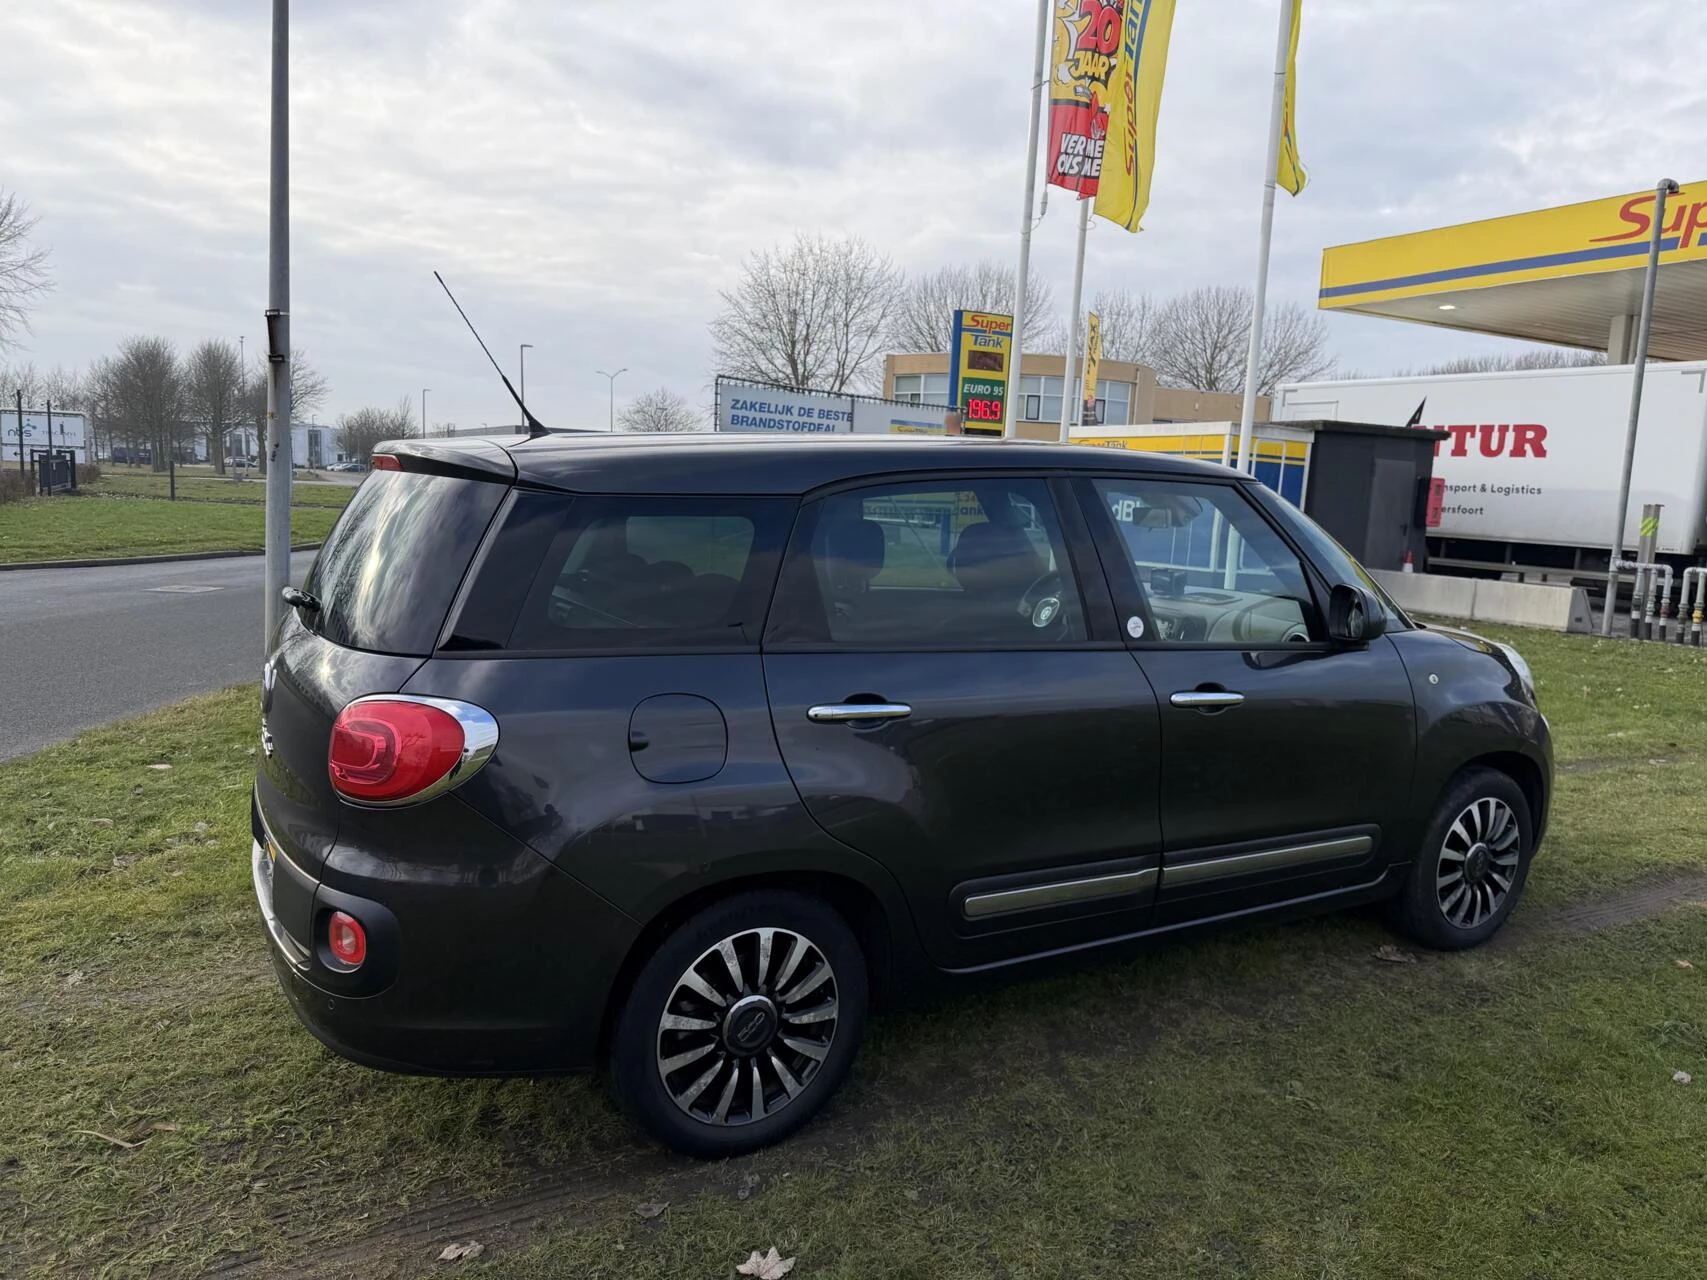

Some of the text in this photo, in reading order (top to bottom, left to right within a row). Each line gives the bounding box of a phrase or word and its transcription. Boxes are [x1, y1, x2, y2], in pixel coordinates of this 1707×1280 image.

[1077, 0, 1122, 55] 20
[1070, 50, 1111, 80] JAAR
[964, 314, 1010, 334] Super
[971, 334, 1003, 348] Tank
[963, 384, 1004, 396] EURO 95
[730, 398, 853, 422] ZAKELIJK DE BESTE
[1413, 424, 1547, 458] TUR
[1480, 484, 1487, 493] &
[1490, 484, 1542, 496] Logistics
